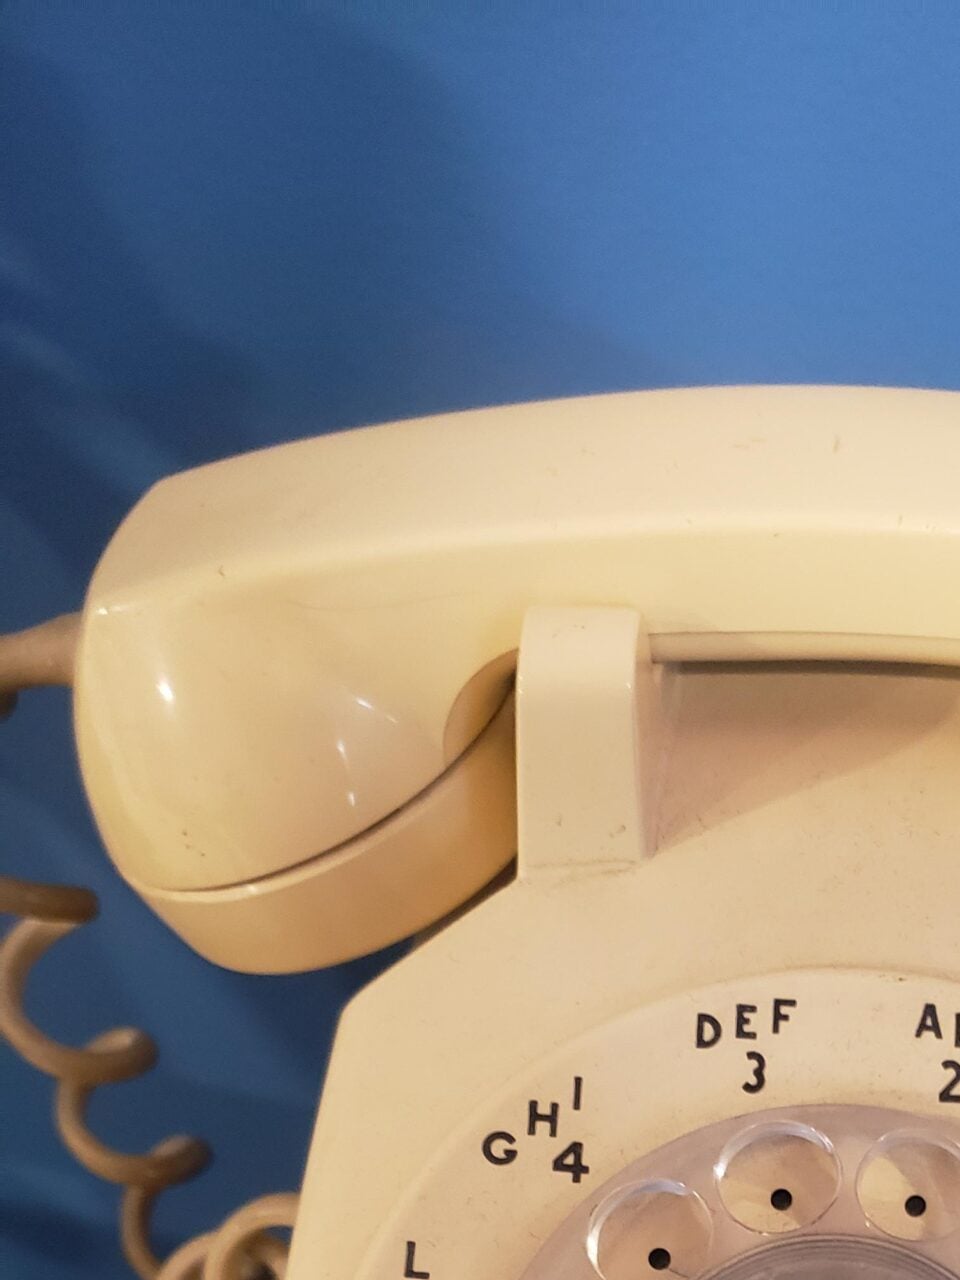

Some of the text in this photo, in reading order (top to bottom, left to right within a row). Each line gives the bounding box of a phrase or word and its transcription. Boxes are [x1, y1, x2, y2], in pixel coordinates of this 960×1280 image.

[696, 999, 796, 1053] DEF
[742, 1051, 765, 1093] 3
[553, 1142, 589, 1183] 4
